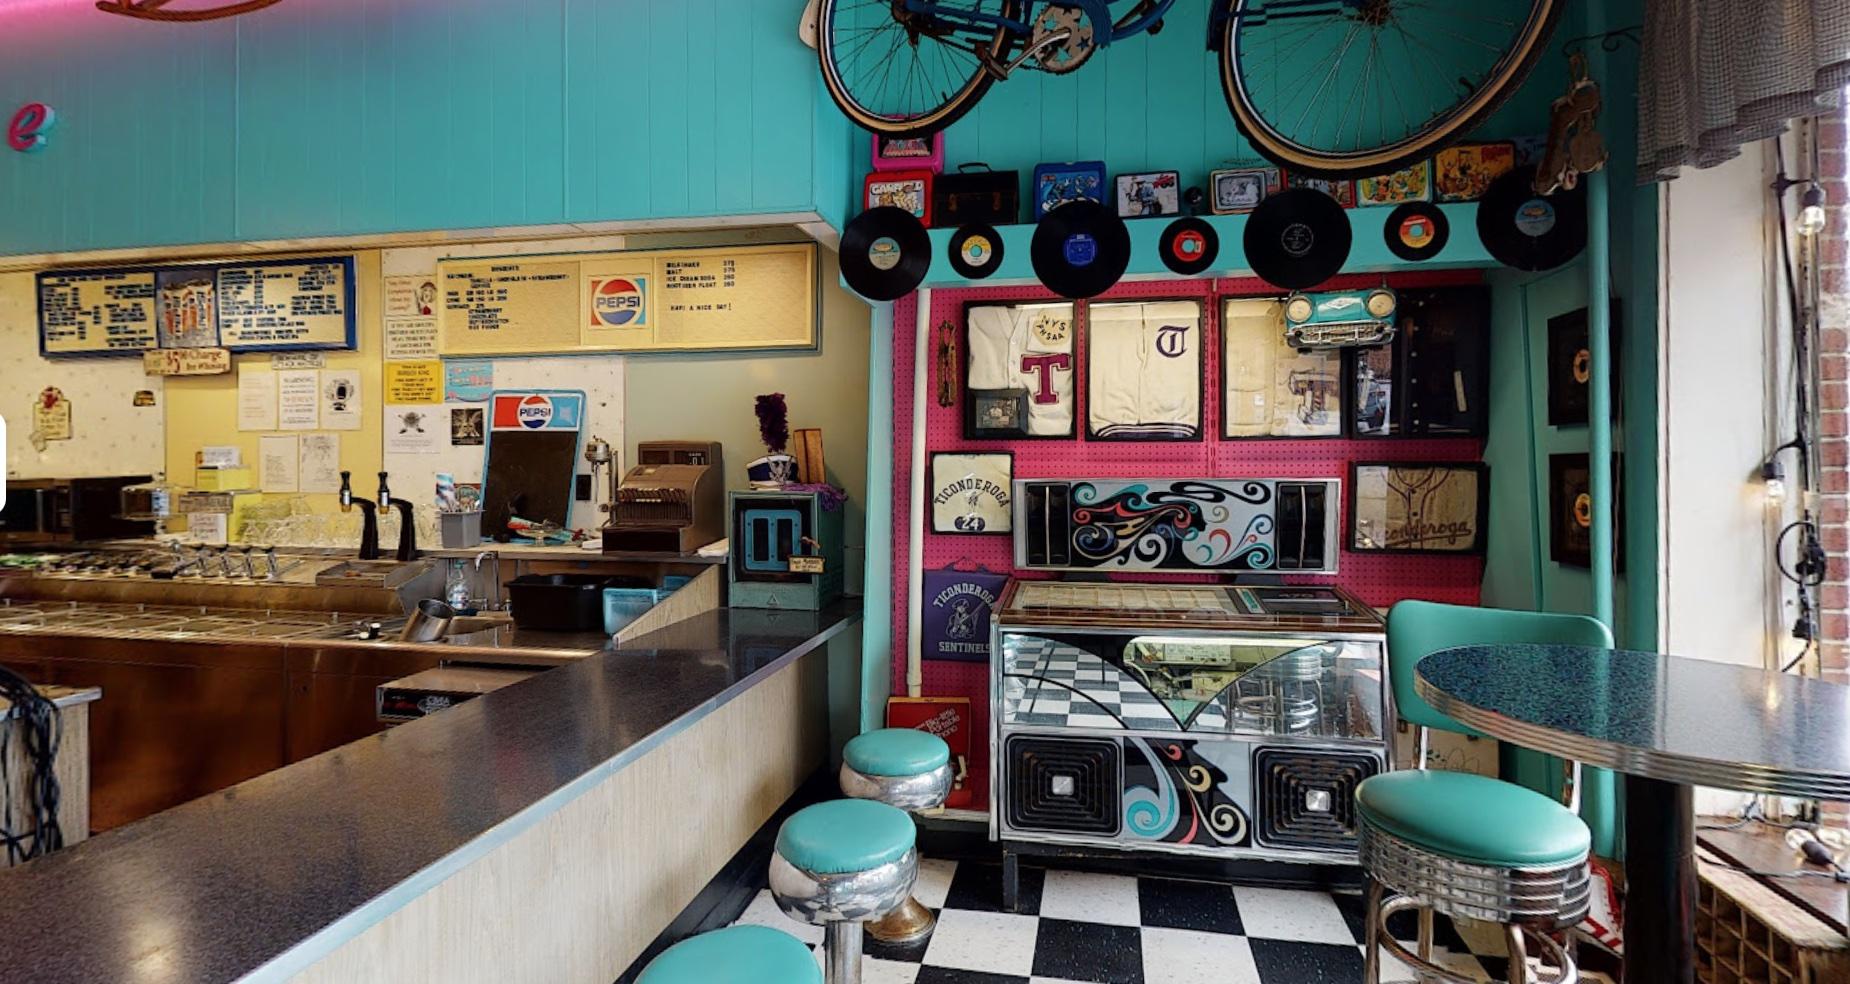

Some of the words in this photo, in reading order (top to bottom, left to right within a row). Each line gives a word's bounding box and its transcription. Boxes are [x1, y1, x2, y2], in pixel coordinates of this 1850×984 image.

[597, 295, 641, 308] PEPSI
[1020, 352, 1071, 405] T
[520, 407, 551, 417] PEPSI
[934, 478, 1010, 507] TICONDEROGA
[933, 583, 995, 608] TICONDEROG
[938, 641, 991, 654] SENTINELS
